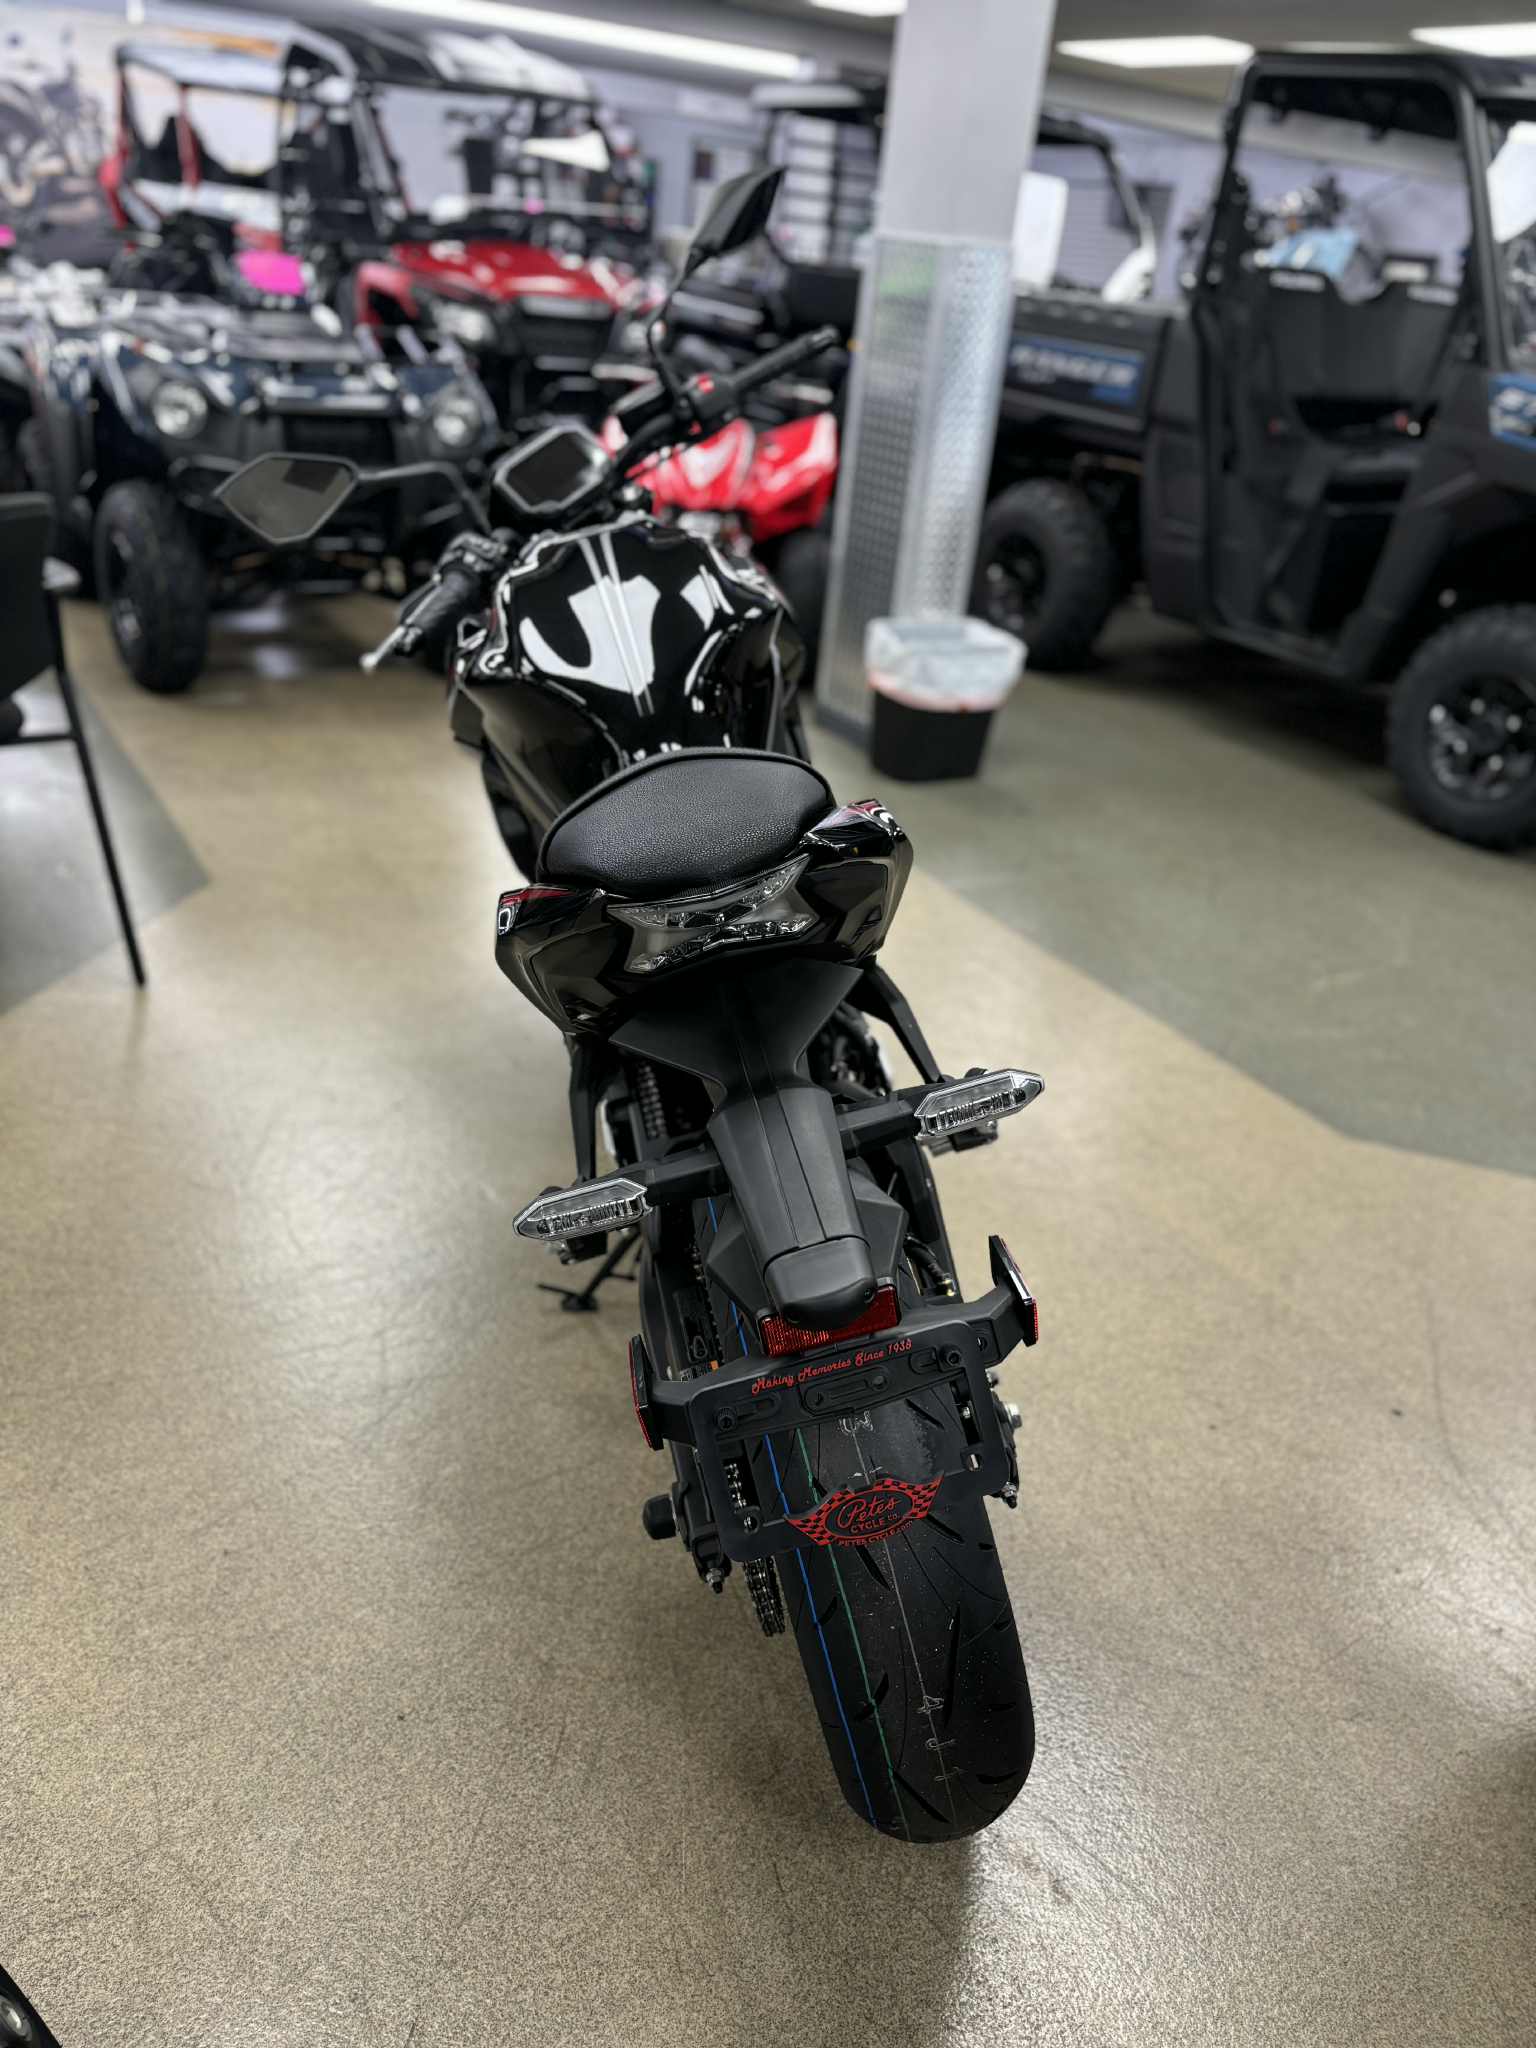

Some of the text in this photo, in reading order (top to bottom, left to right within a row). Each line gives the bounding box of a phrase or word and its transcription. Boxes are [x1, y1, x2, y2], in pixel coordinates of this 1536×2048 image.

[751, 1338, 912, 1394] Making Memories Since 1938
[838, 1496, 901, 1528] Petes
[850, 1518, 884, 1534] CYCLE
